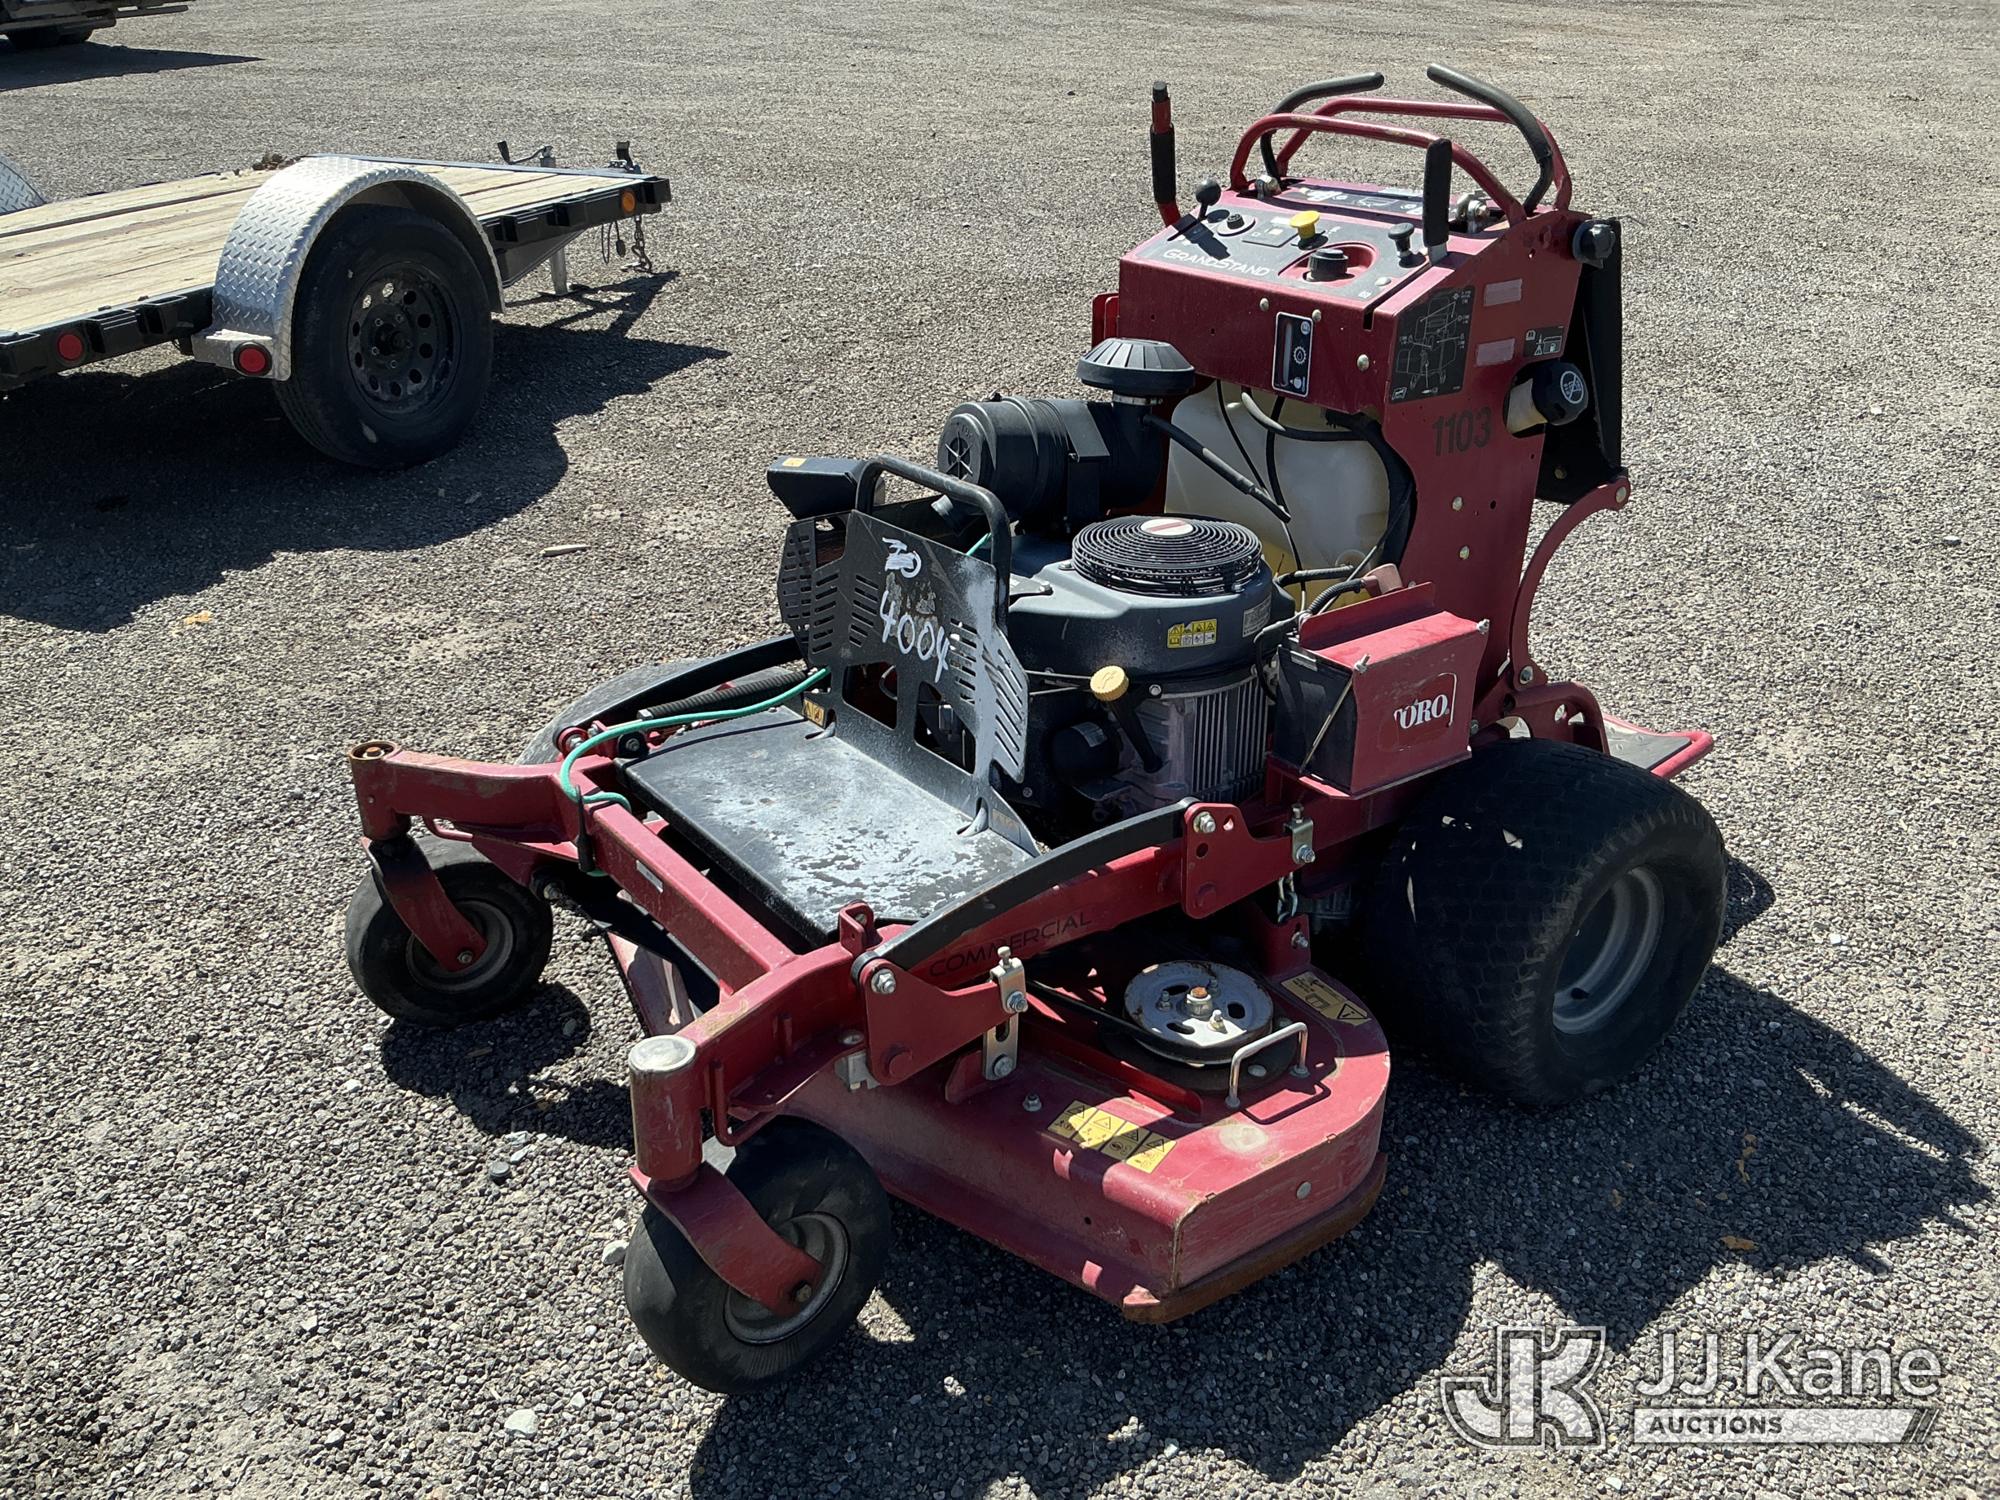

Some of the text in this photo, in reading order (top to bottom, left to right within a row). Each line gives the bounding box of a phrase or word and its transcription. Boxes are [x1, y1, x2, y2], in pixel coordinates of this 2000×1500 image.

[1163, 248, 1271, 277] GRANDSTAND
[1432, 405, 1493, 457] 1103
[879, 589, 950, 683] 4004
